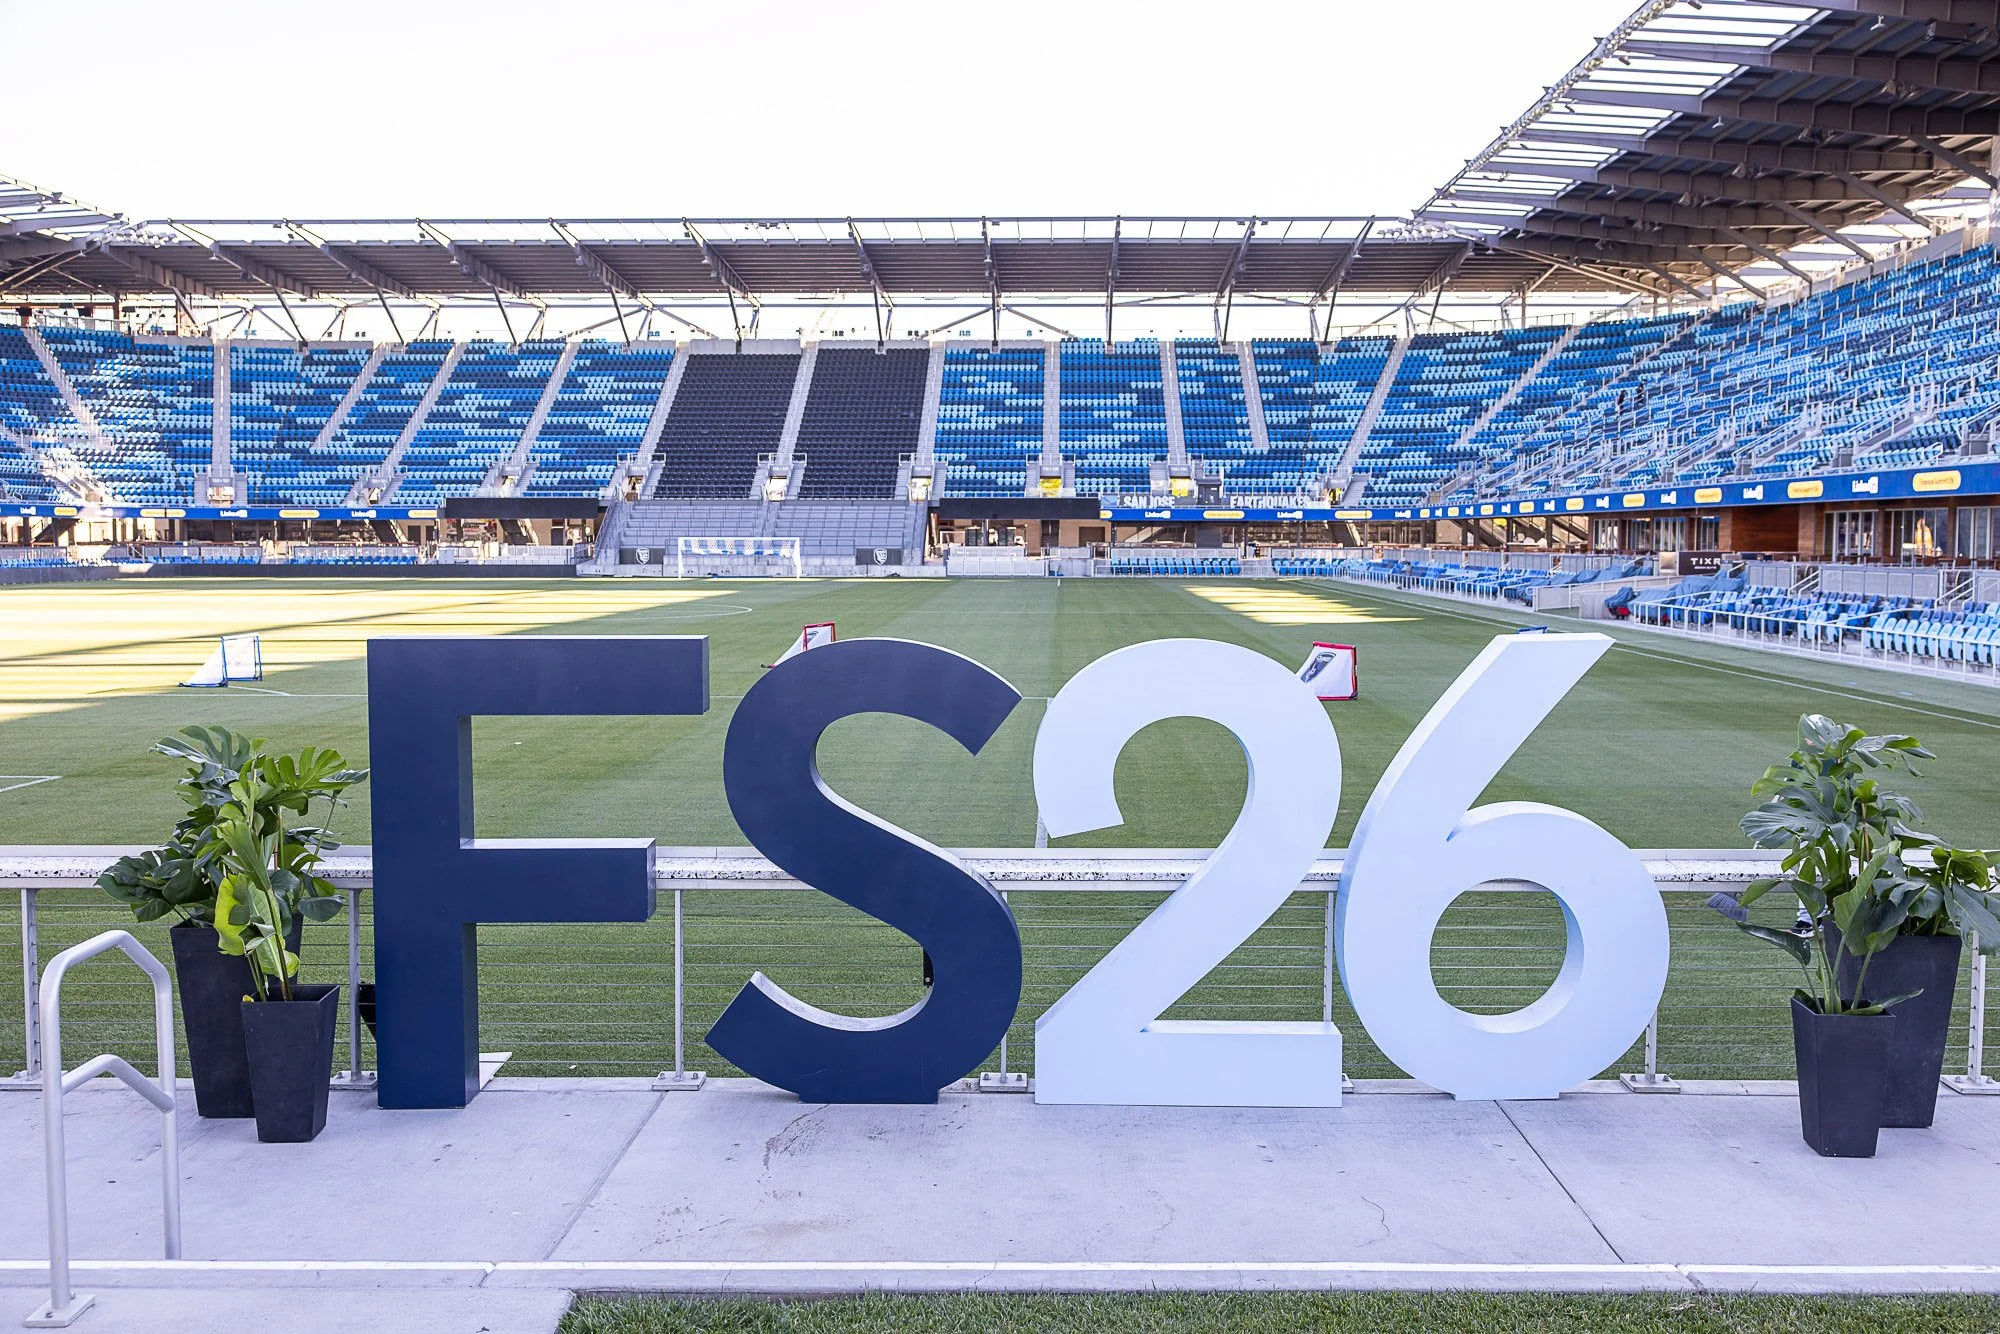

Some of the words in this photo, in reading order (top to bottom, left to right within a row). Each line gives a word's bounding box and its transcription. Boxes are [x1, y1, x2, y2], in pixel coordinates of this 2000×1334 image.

[1123, 496, 1147, 509] SAN
[1148, 496, 1176, 509] JOSE
[1690, 557, 1721, 566] TIXR
[367, 633, 1670, 1109] FS26
